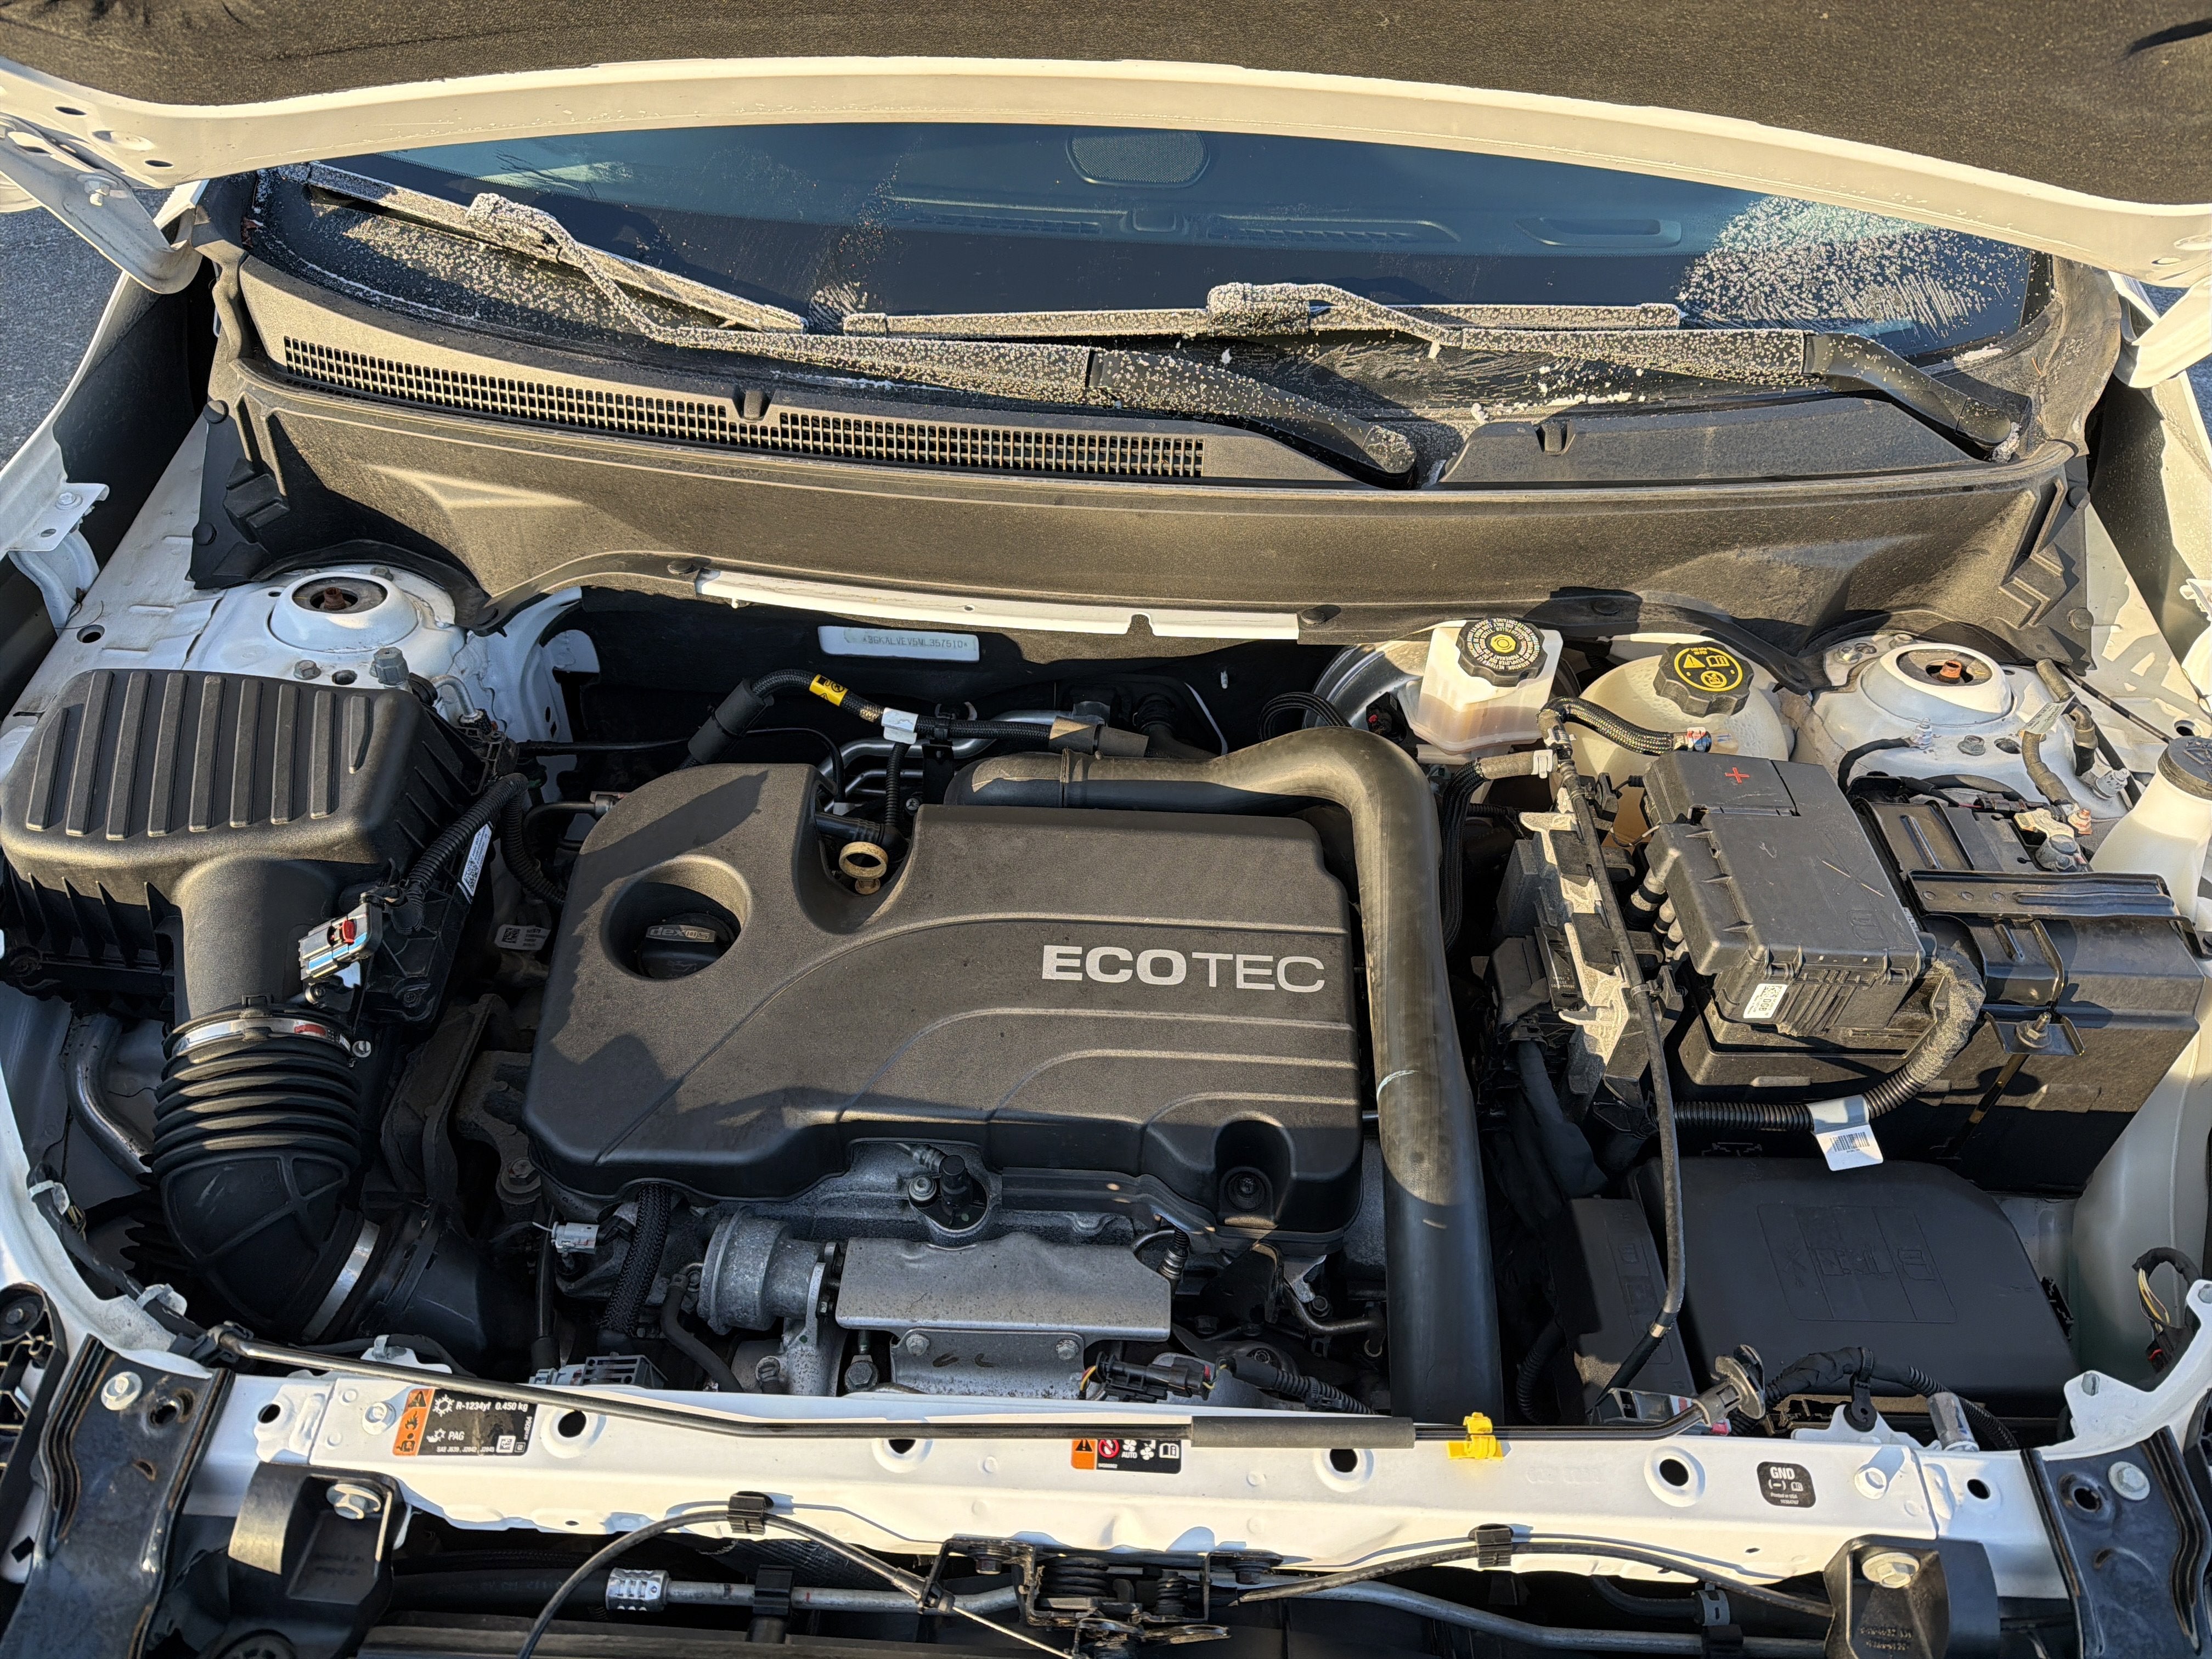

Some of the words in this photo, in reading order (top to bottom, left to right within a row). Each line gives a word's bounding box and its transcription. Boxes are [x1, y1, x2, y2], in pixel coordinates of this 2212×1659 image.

[1041, 944, 1326, 993] ECOTEC
[495, 1402, 517, 1411] 0.450
[517, 1402, 528, 1413] kg
[448, 1431, 465, 1441] PAG
[1770, 1466, 1795, 1480] GND
